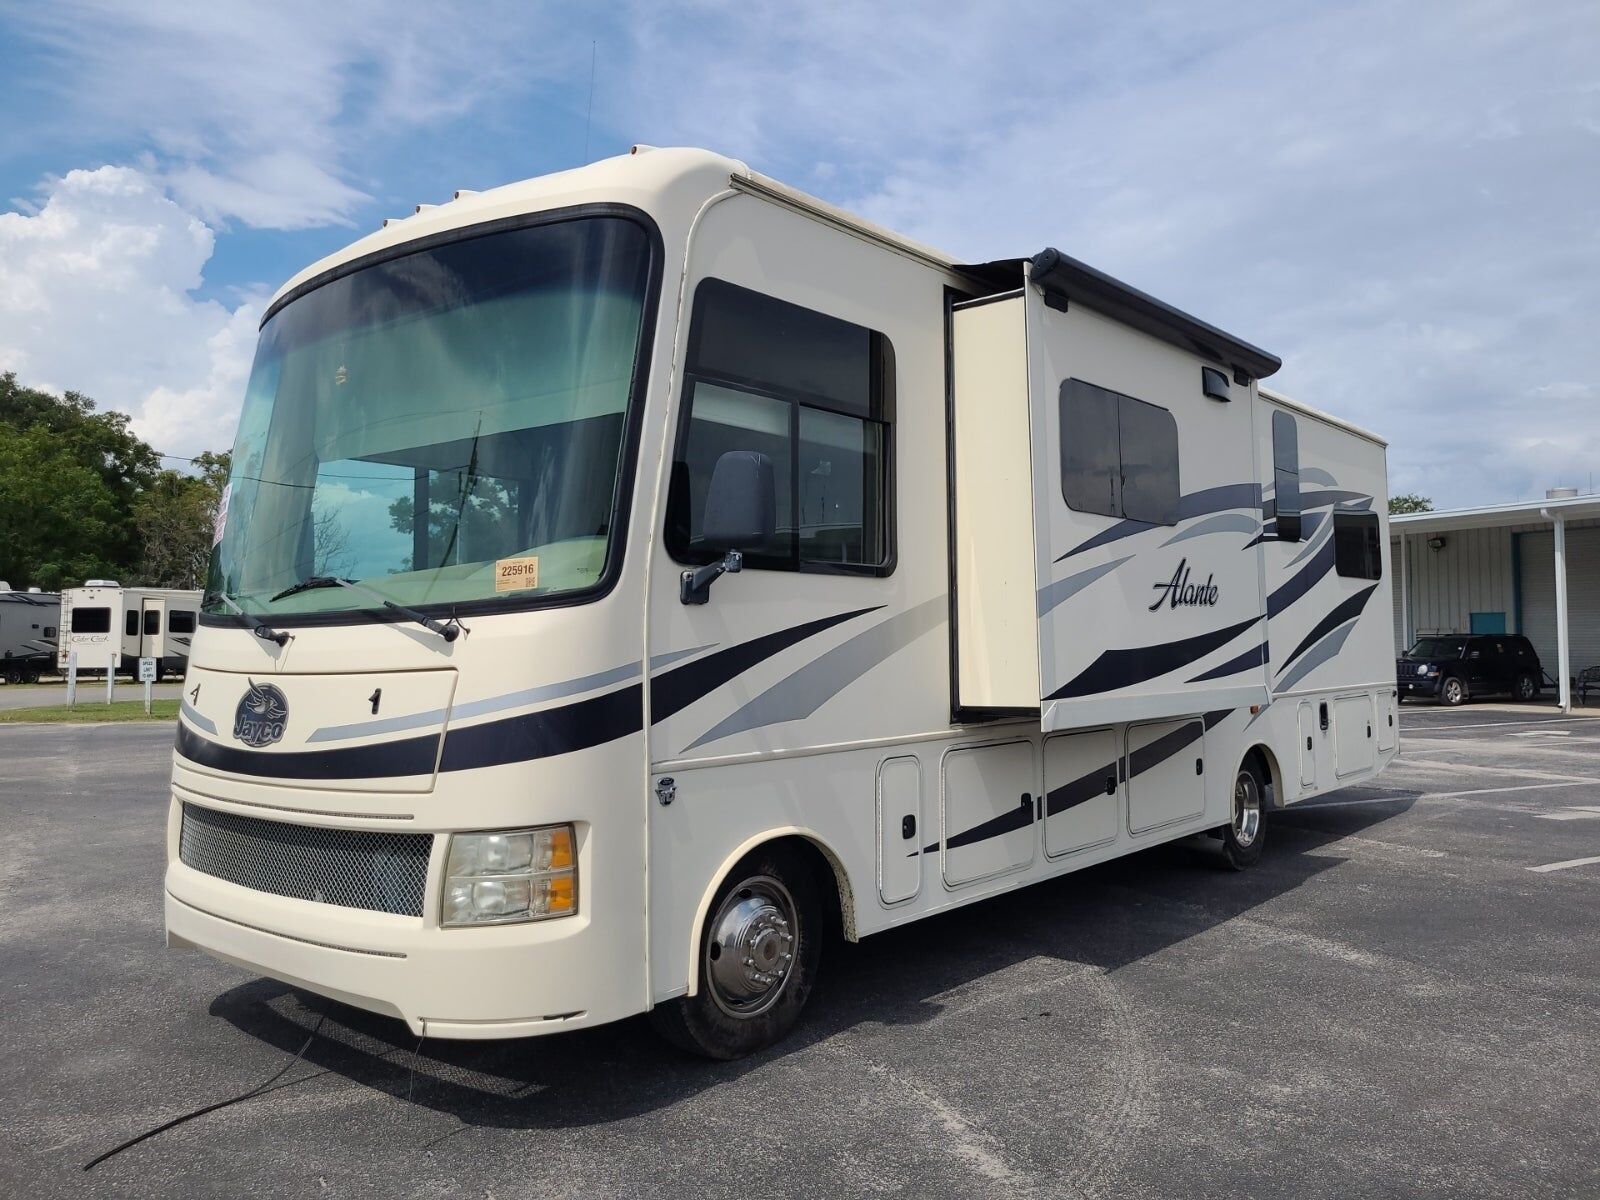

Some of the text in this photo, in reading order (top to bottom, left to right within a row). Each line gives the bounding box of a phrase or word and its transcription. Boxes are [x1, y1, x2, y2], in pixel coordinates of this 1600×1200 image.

[502, 564, 534, 577] 225916
[1148, 557, 1219, 611] Alante
[233, 714, 285, 744] Jayco
